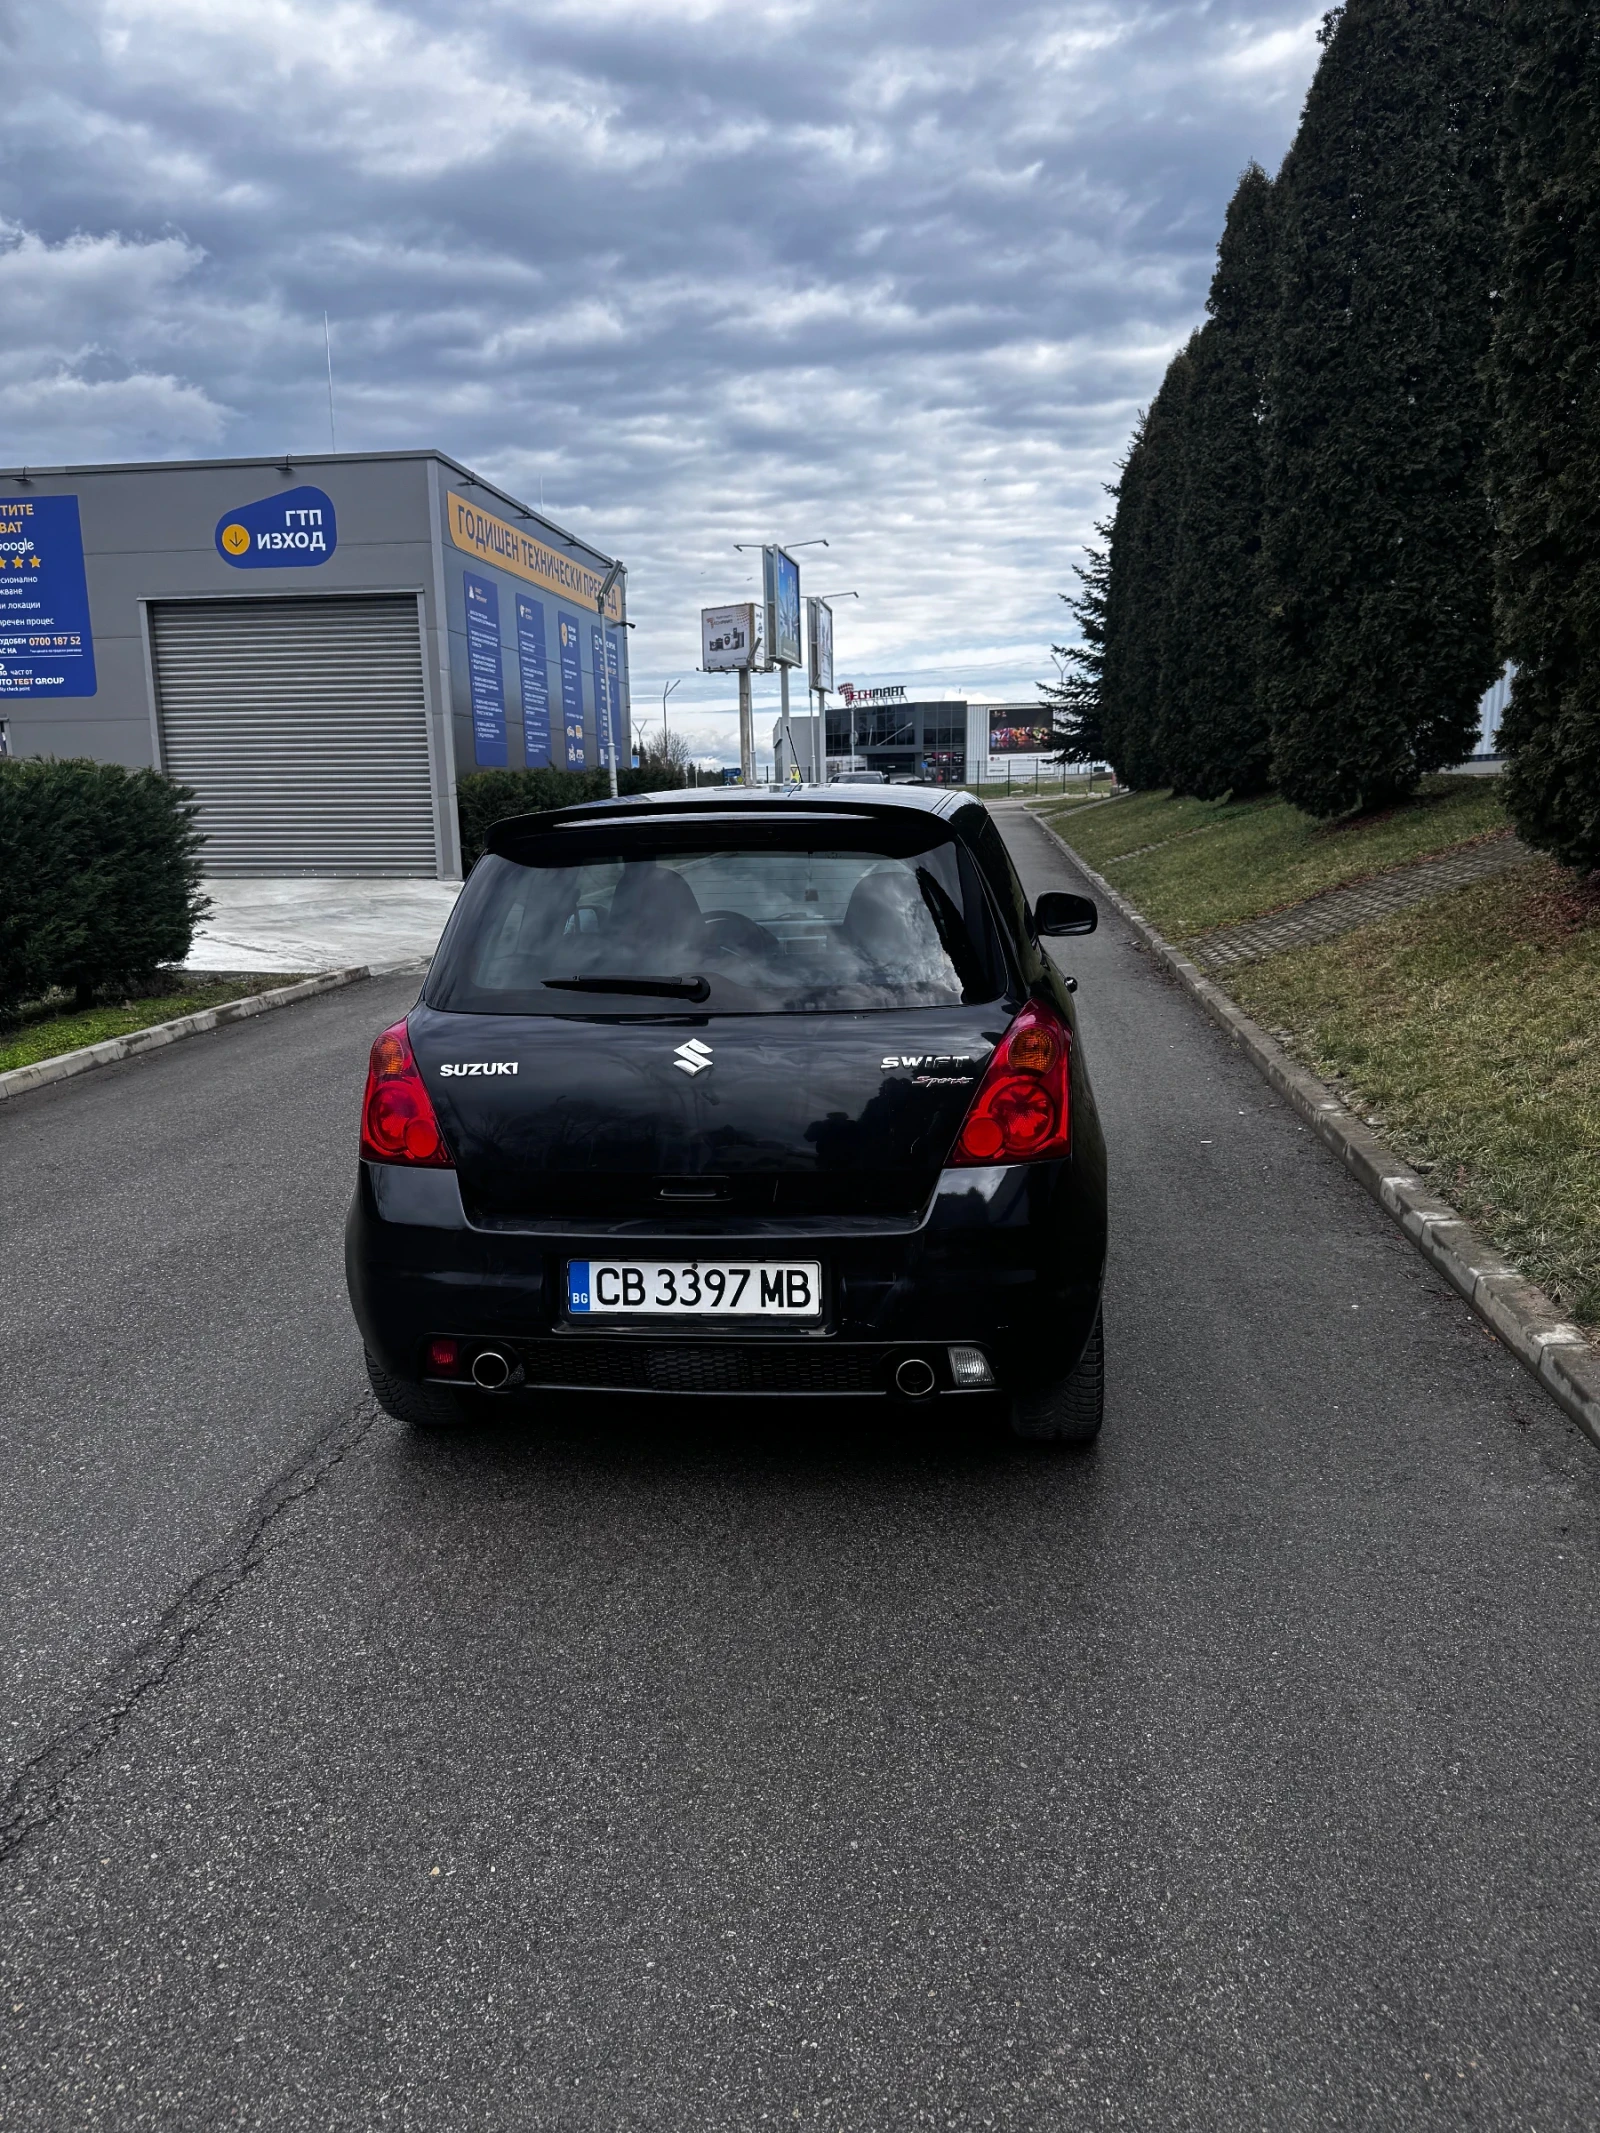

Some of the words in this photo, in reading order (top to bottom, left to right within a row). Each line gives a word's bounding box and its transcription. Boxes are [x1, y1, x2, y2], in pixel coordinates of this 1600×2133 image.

[285, 509, 323, 527] ГТП
[0, 537, 34, 554] oogle
[256, 531, 326, 551] ИЗХОД
[457, 504, 520, 563] ГОДИШЕН
[521, 539, 583, 595] ТЕХНИЧЕСКИ
[26, 618, 55, 627] процес
[29, 637, 51, 646] 0700
[52, 636, 68, 645] 187
[70, 636, 82, 645] 52
[35, 677, 65, 685] GROUP
[880, 1055, 970, 1069] SWIFT
[440, 1062, 518, 1077] SUZUKI
[911, 1075, 974, 1088] Sport
[596, 1267, 646, 1307] CB
[655, 1268, 751, 1308] 3397
[760, 1269, 811, 1308] MB
[572, 1292, 589, 1304] BG
